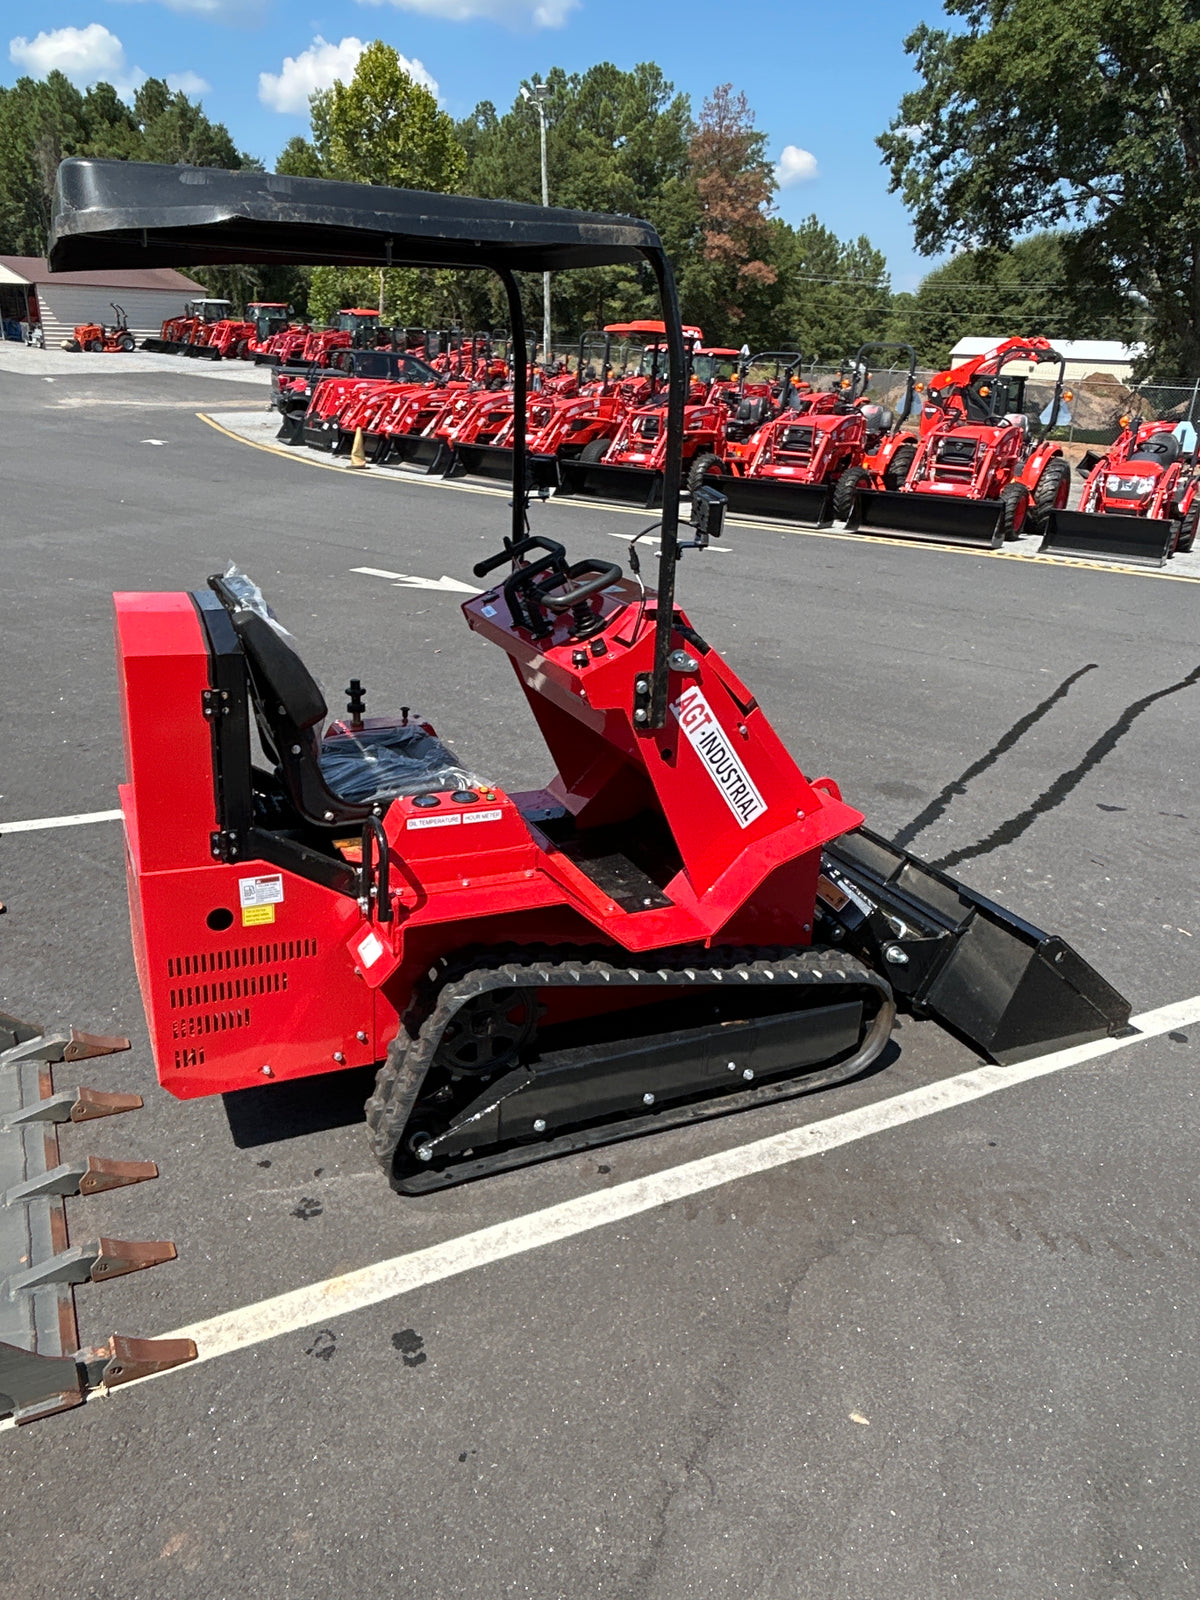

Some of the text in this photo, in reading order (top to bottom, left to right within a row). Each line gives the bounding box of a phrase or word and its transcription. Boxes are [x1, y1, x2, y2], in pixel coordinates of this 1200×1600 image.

[674, 692, 759, 822] AGT INDUSTRIAL
[481, 811, 501, 819] METER
[419, 816, 460, 826] TEMPERATURE
